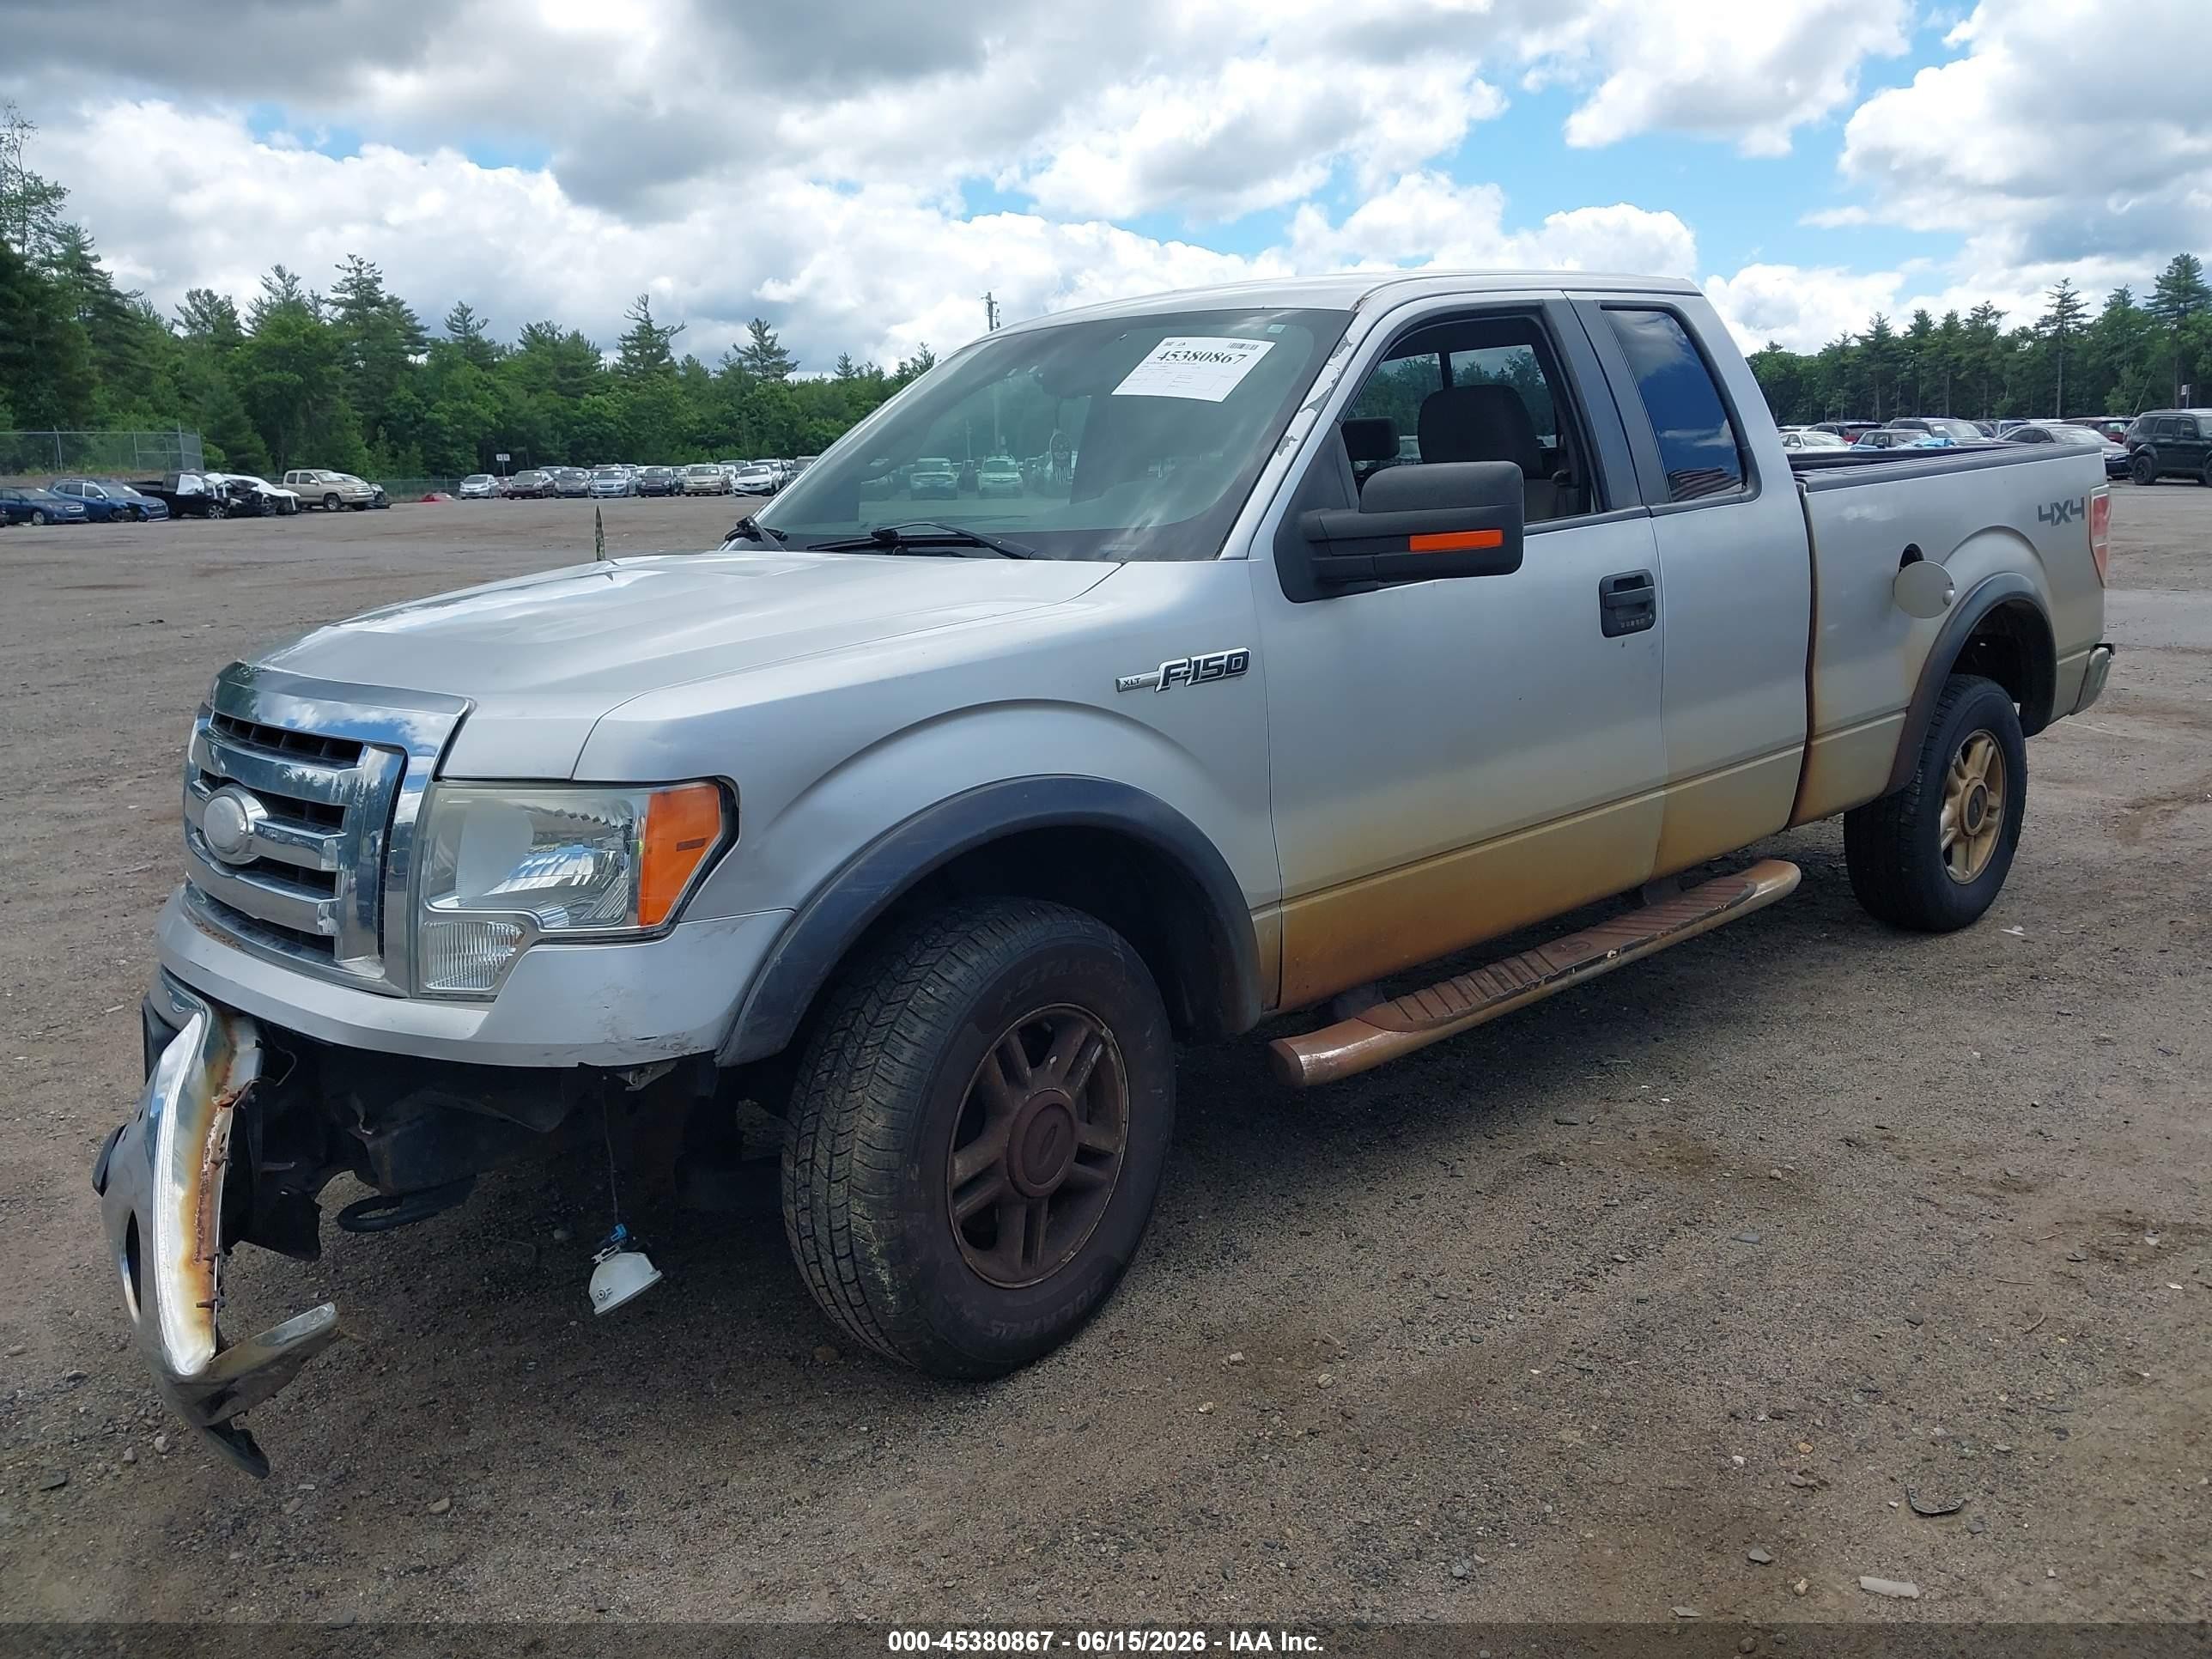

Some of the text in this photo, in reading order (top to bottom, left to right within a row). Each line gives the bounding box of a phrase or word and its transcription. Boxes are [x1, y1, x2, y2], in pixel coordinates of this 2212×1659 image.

[1157, 349, 1249, 365] 45380867
[2038, 496, 2085, 526] 4X4
[1122, 647, 1251, 692] XLT F-150
